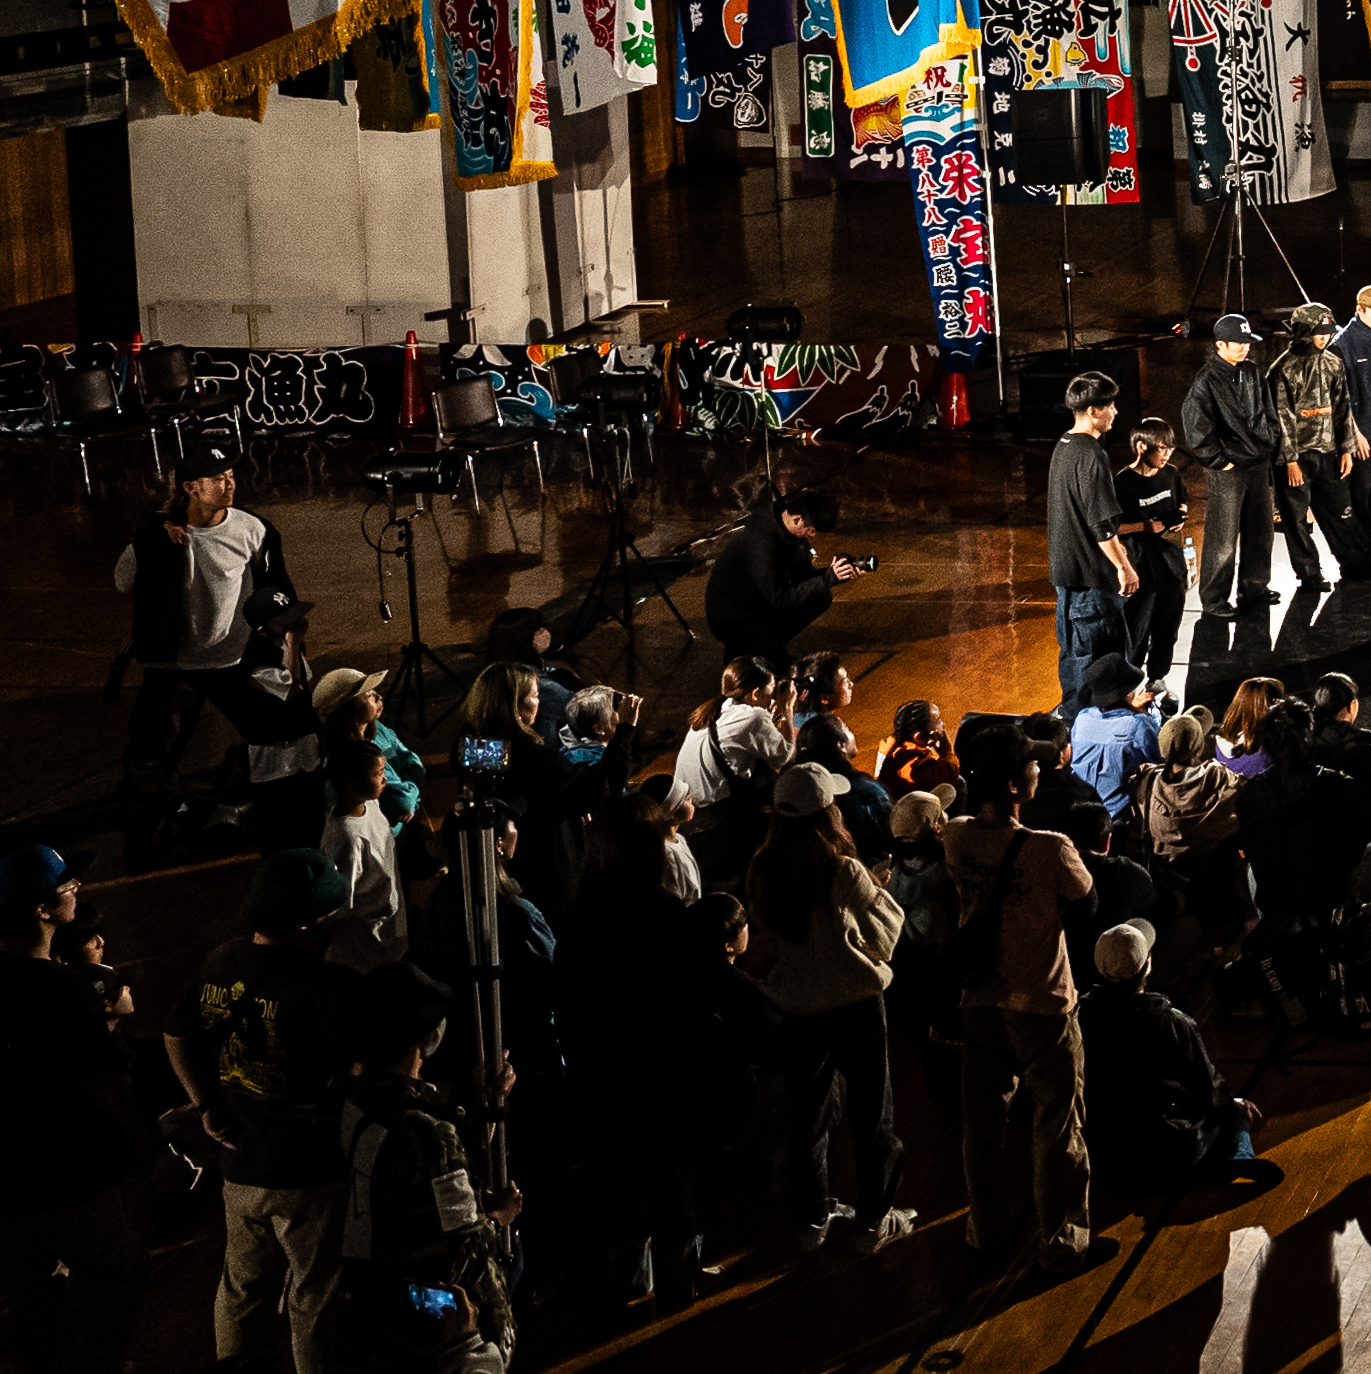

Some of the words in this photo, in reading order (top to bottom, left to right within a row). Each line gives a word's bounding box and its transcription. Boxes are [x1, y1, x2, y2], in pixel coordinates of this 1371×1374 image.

[1283, 21, 1311, 52] 大
[923, 65, 950, 91] 祝
[911, 147, 945, 225] 第八十八
[929, 233, 949, 256] 贈
